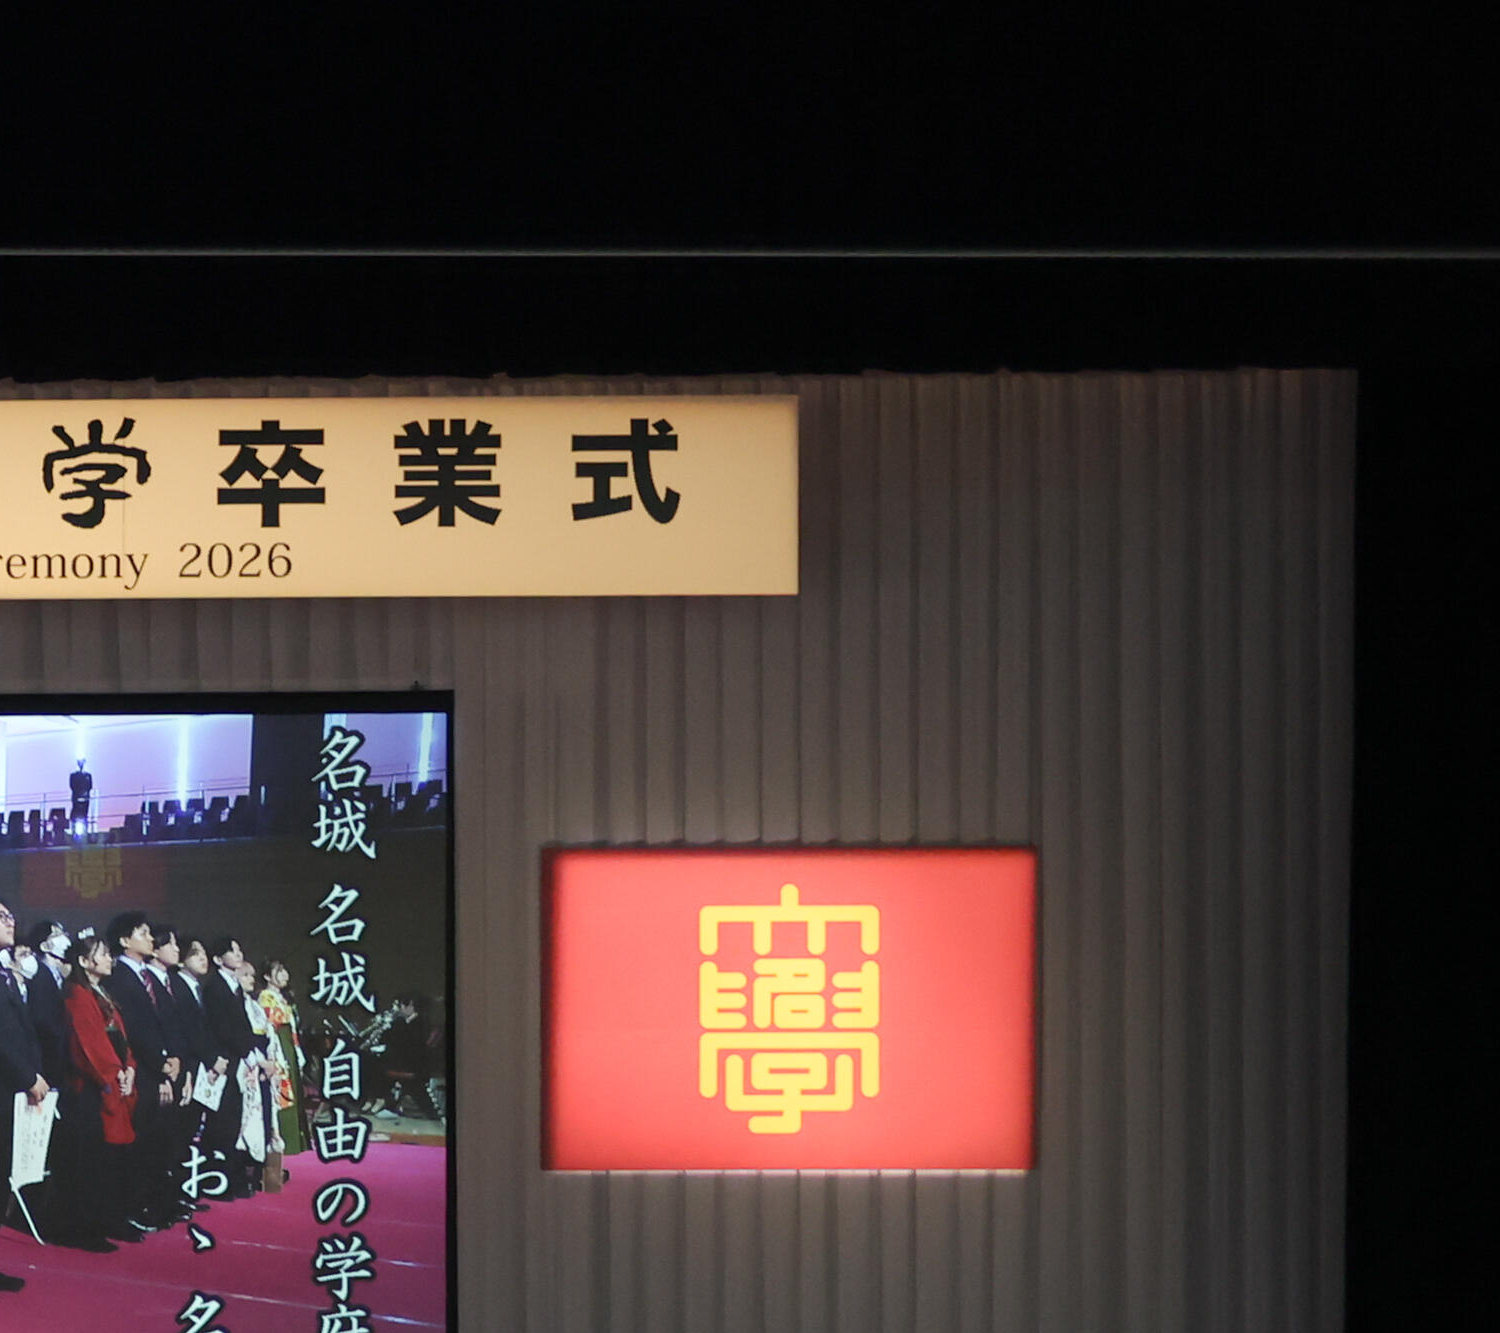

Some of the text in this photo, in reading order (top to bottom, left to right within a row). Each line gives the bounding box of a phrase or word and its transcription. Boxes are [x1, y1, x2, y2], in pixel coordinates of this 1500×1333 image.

[178, 542, 293, 579] 2026
[310, 727, 376, 859] 名城
[310, 883, 376, 1013] 名城
